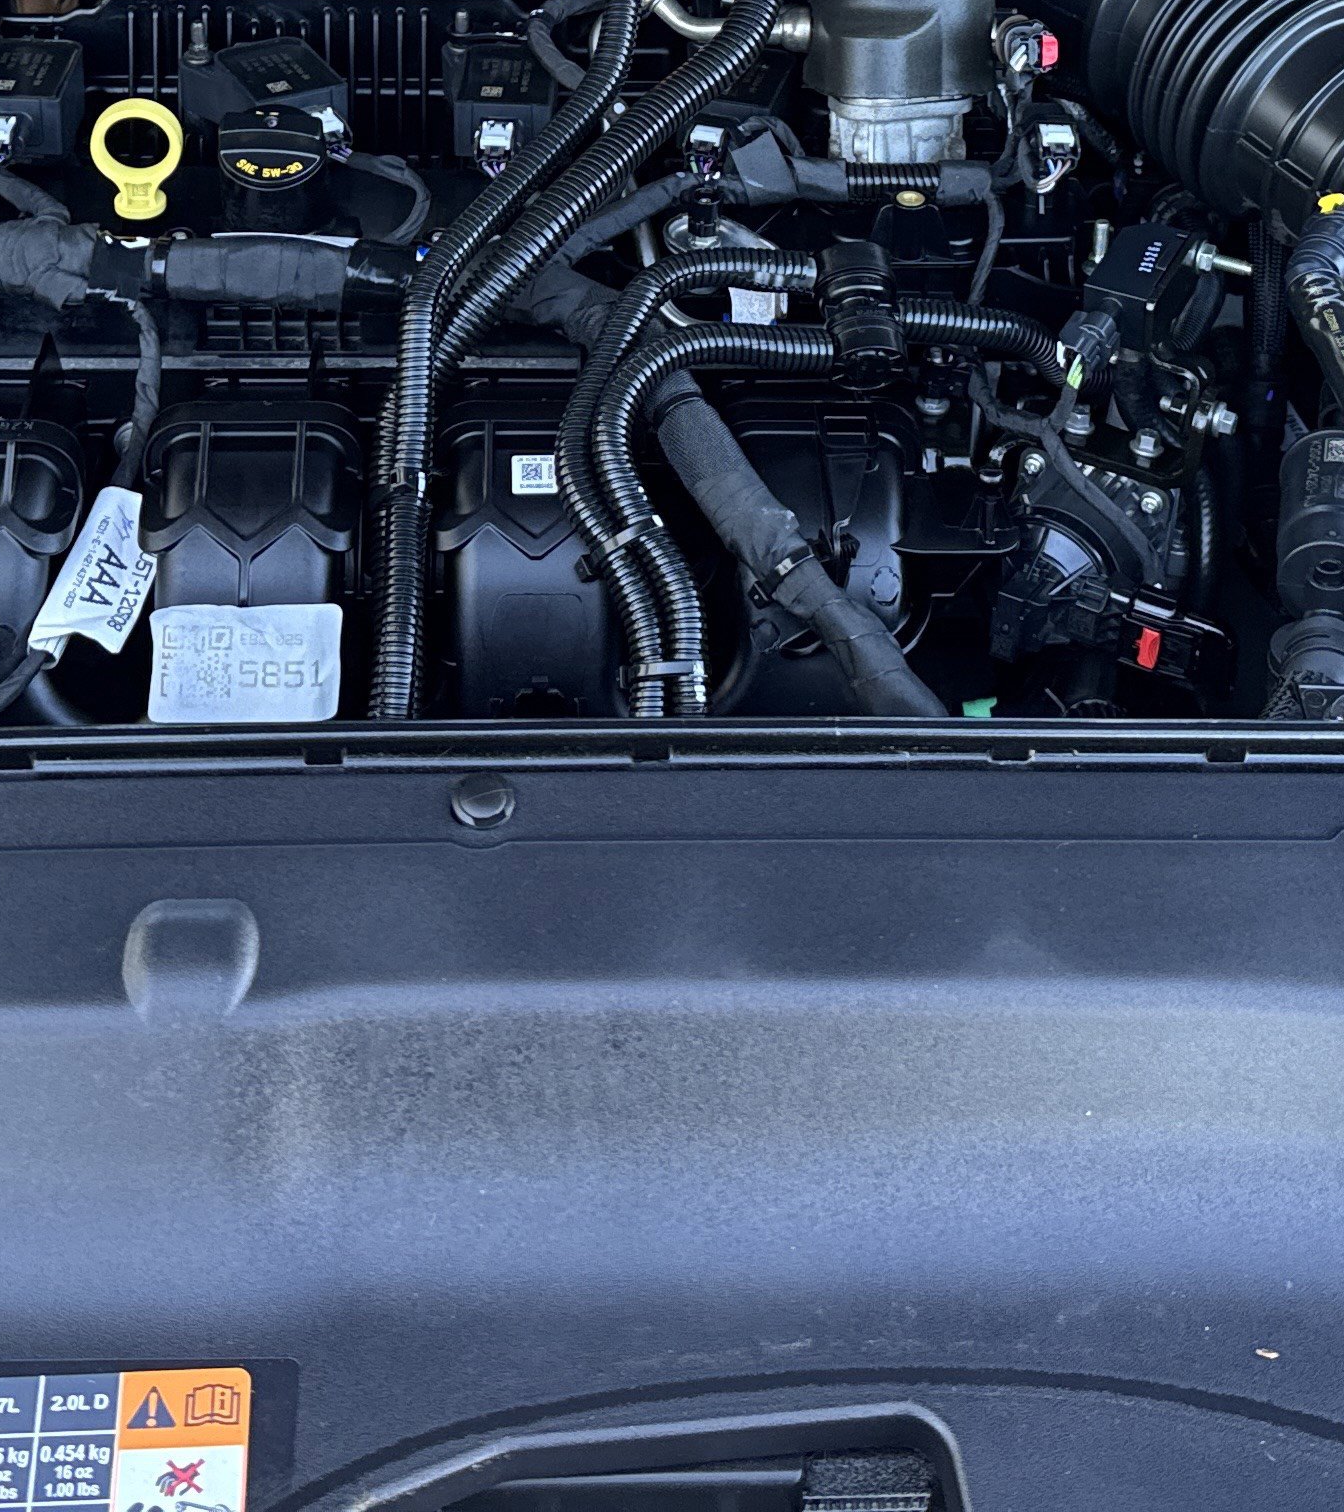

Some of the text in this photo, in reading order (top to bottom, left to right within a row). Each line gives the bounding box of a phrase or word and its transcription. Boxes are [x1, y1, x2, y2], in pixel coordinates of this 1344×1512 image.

[235, 158, 304, 178] SAE 5W-30
[79, 543, 128, 606] AAA
[238, 659, 324, 688] 5851
[50, 1393, 109, 1412] 2.0L D
[8, 1447, 30, 1468] kg
[40, 1443, 111, 1465] 0.454 kg
[55, 1465, 94, 1479] 16 oz
[44, 1481, 100, 1498] 1.00 lbs
